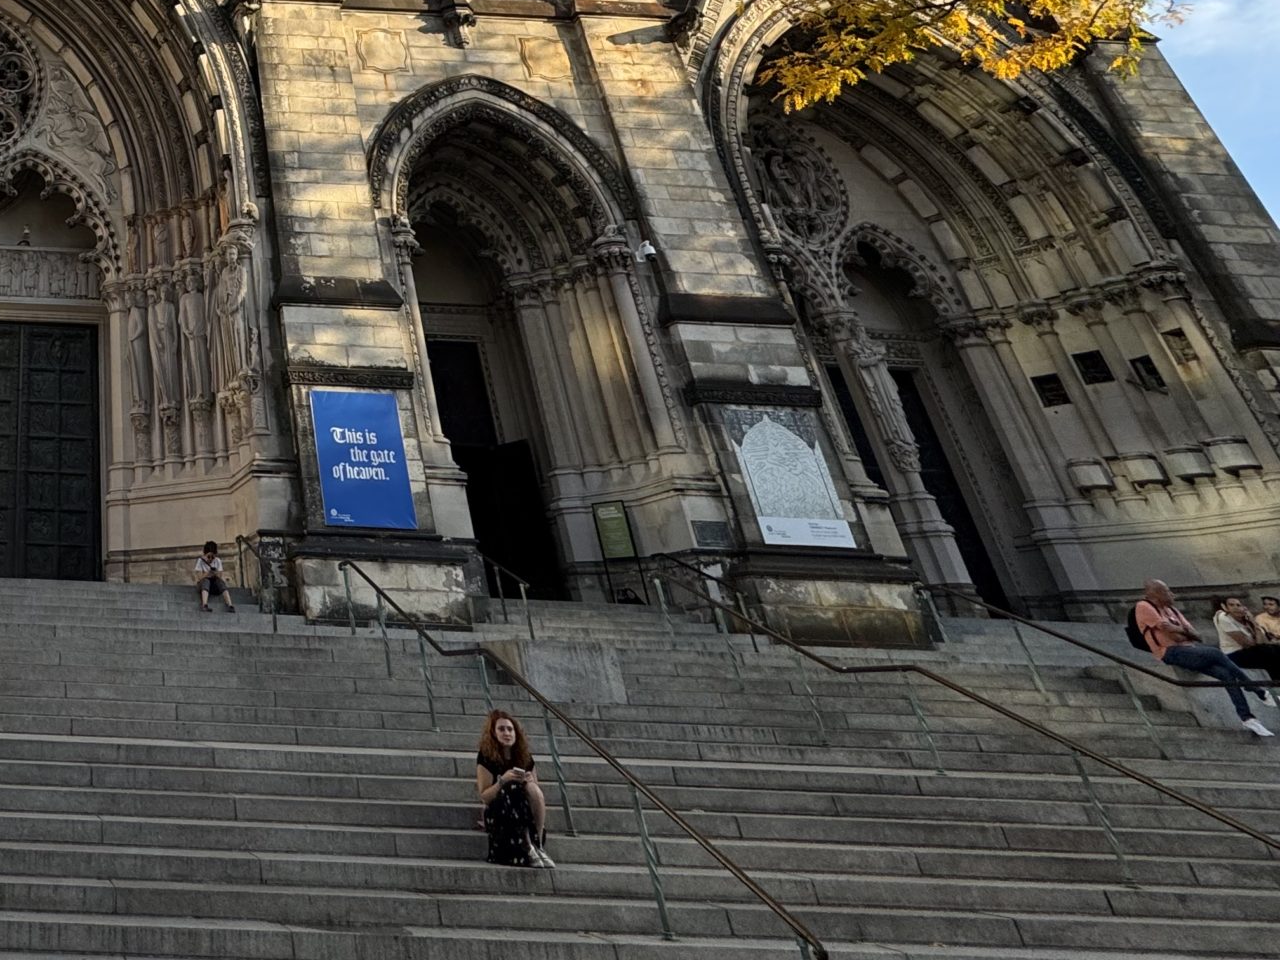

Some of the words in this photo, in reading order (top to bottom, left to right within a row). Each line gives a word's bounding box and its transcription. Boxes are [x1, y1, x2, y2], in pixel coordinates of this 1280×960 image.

[330, 427, 363, 444] This
[366, 429, 377, 445] is
[350, 446, 368, 463] the
[370, 449, 396, 465] gate
[332, 463, 346, 481] of
[346, 464, 390, 480] heaven.
